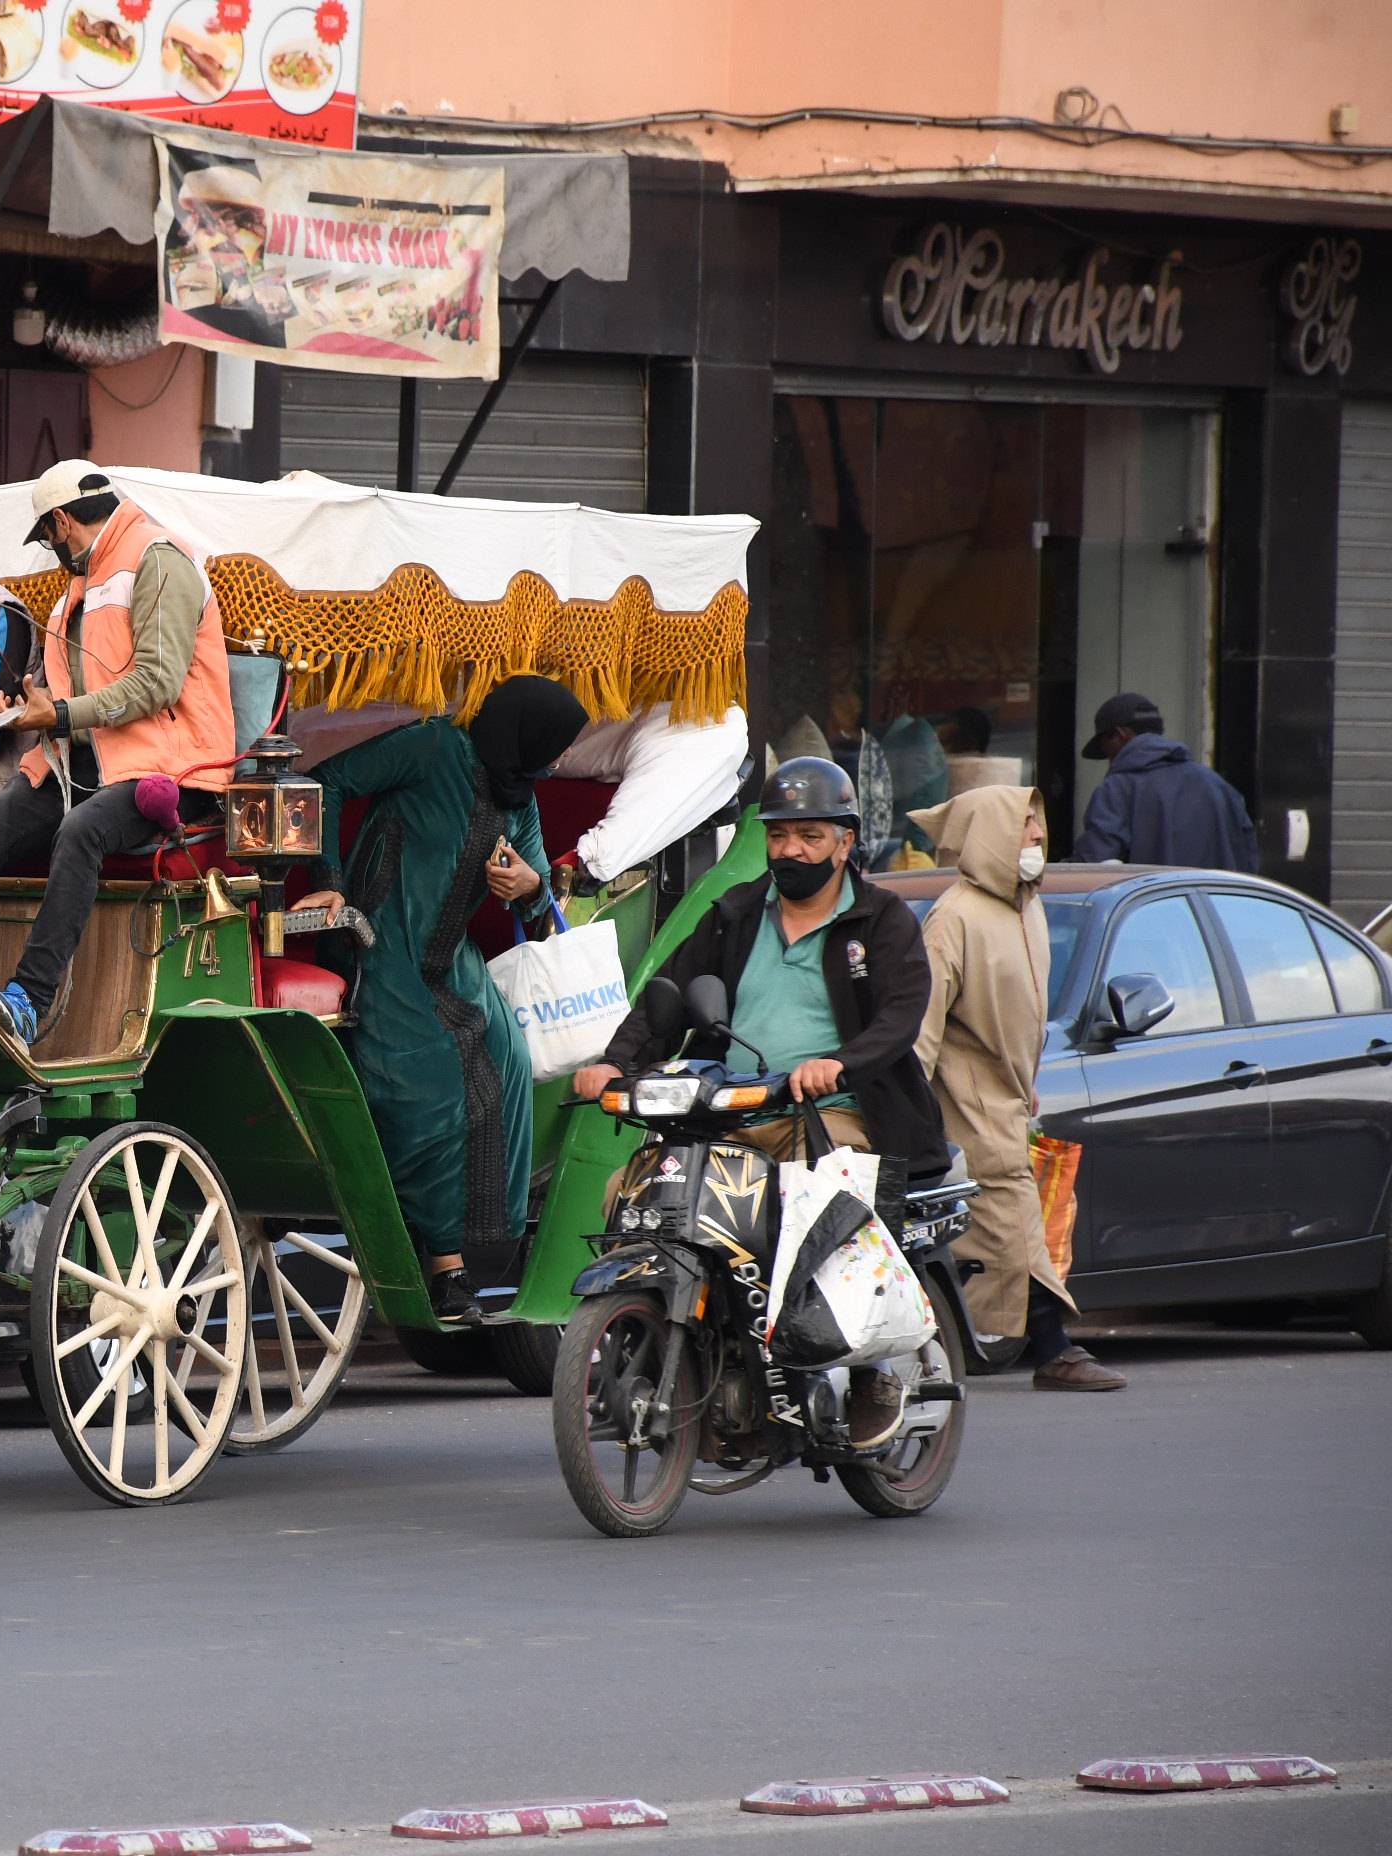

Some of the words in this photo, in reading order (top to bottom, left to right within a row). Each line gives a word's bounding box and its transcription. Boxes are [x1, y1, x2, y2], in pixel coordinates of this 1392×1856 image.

[267, 212, 299, 257] MY
[304, 216, 382, 265] EXPRESS
[388, 226, 452, 270] SNACK
[883, 222, 1183, 374] Marrakech
[180, 923, 221, 978] 74
